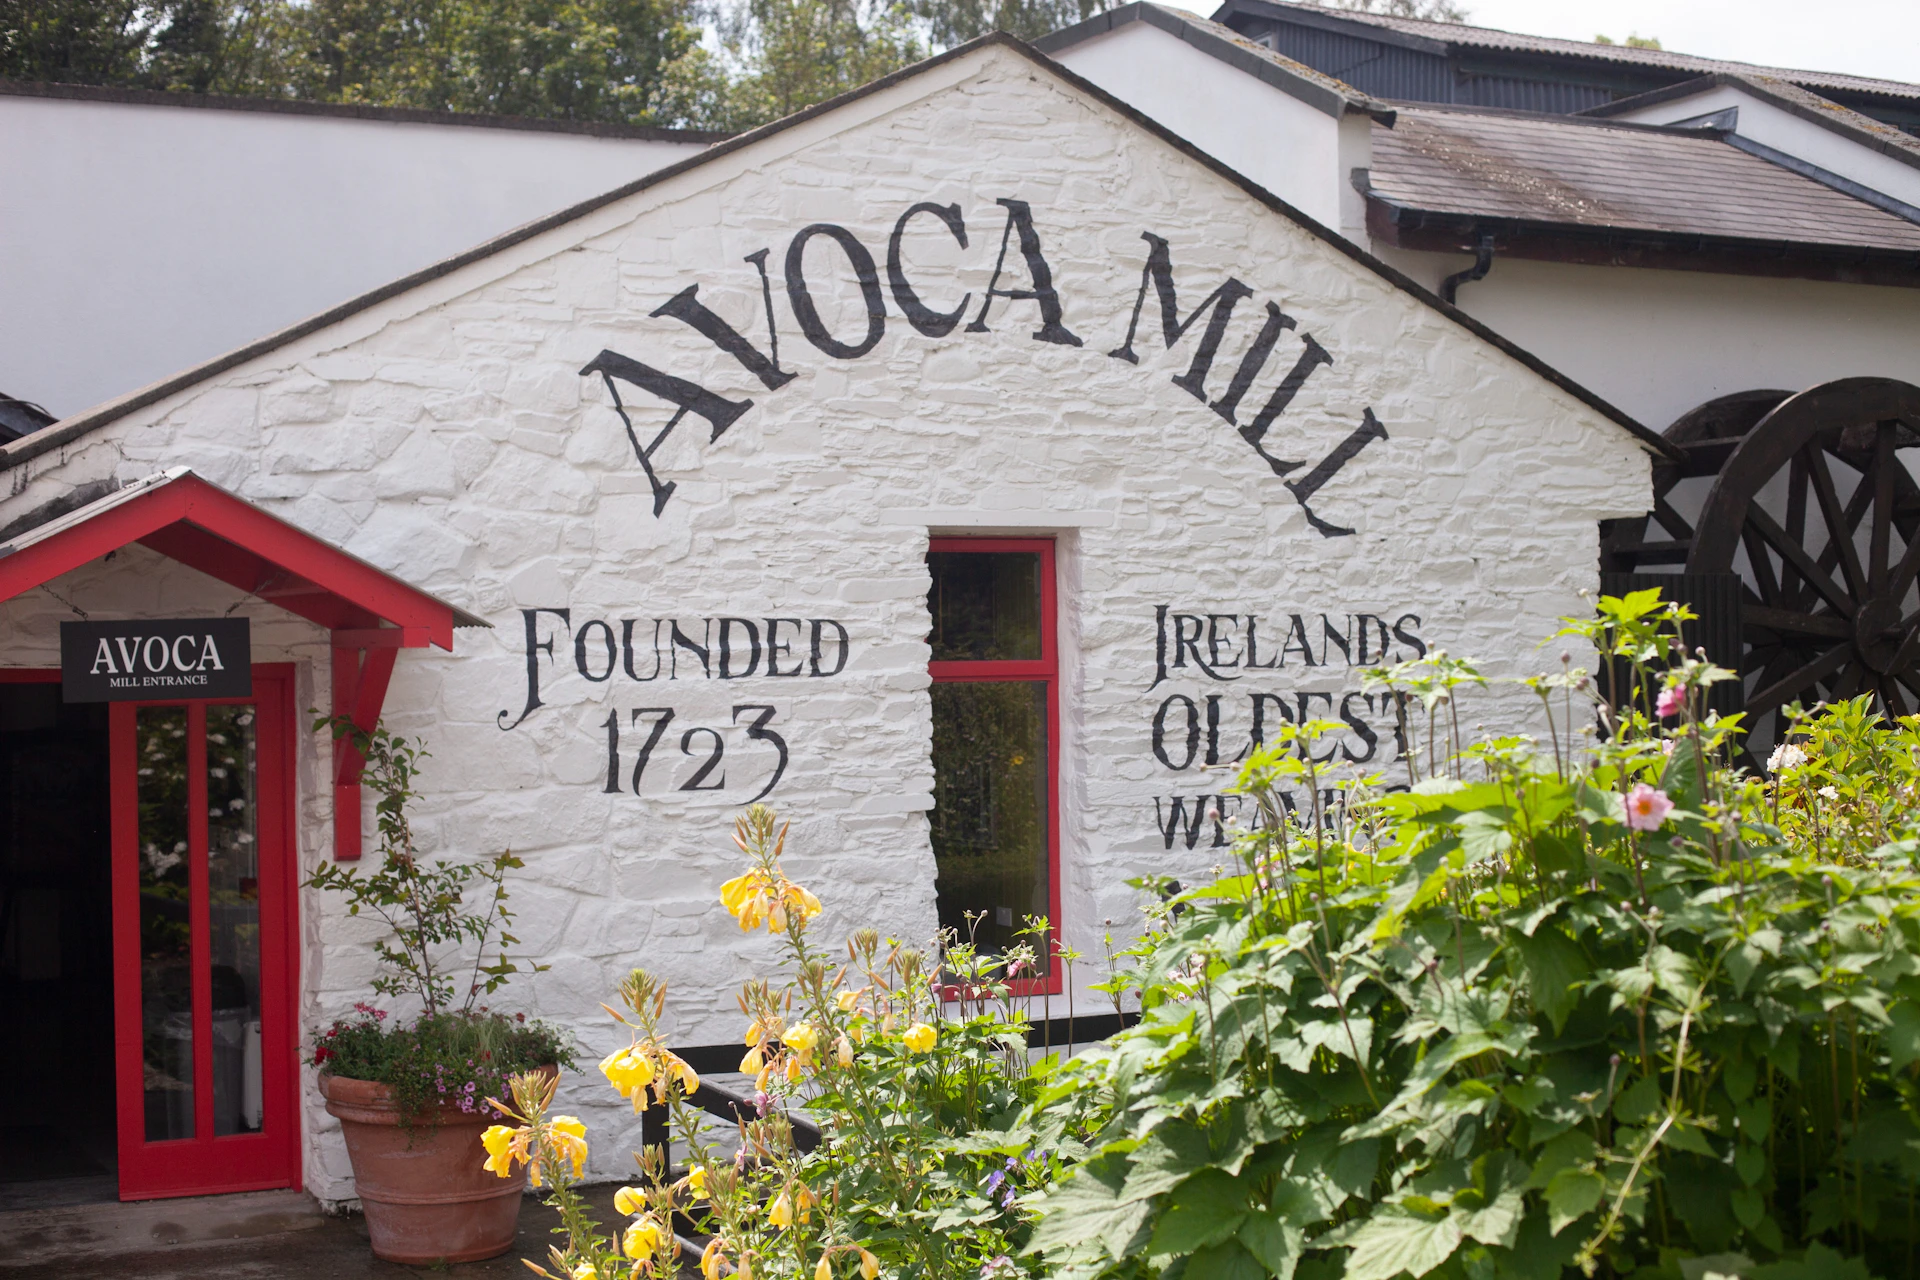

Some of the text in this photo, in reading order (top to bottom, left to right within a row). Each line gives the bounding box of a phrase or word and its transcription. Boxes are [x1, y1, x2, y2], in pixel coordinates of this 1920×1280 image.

[577, 193, 1390, 538] AVOCA MILL
[90, 635, 224, 675] AVOCA
[110, 675, 208, 688] MILL ENTRANCE
[498, 608, 849, 731] FOUNDED
[601, 705, 788, 805] 1723
[1152, 692, 1425, 771] OLDEST
